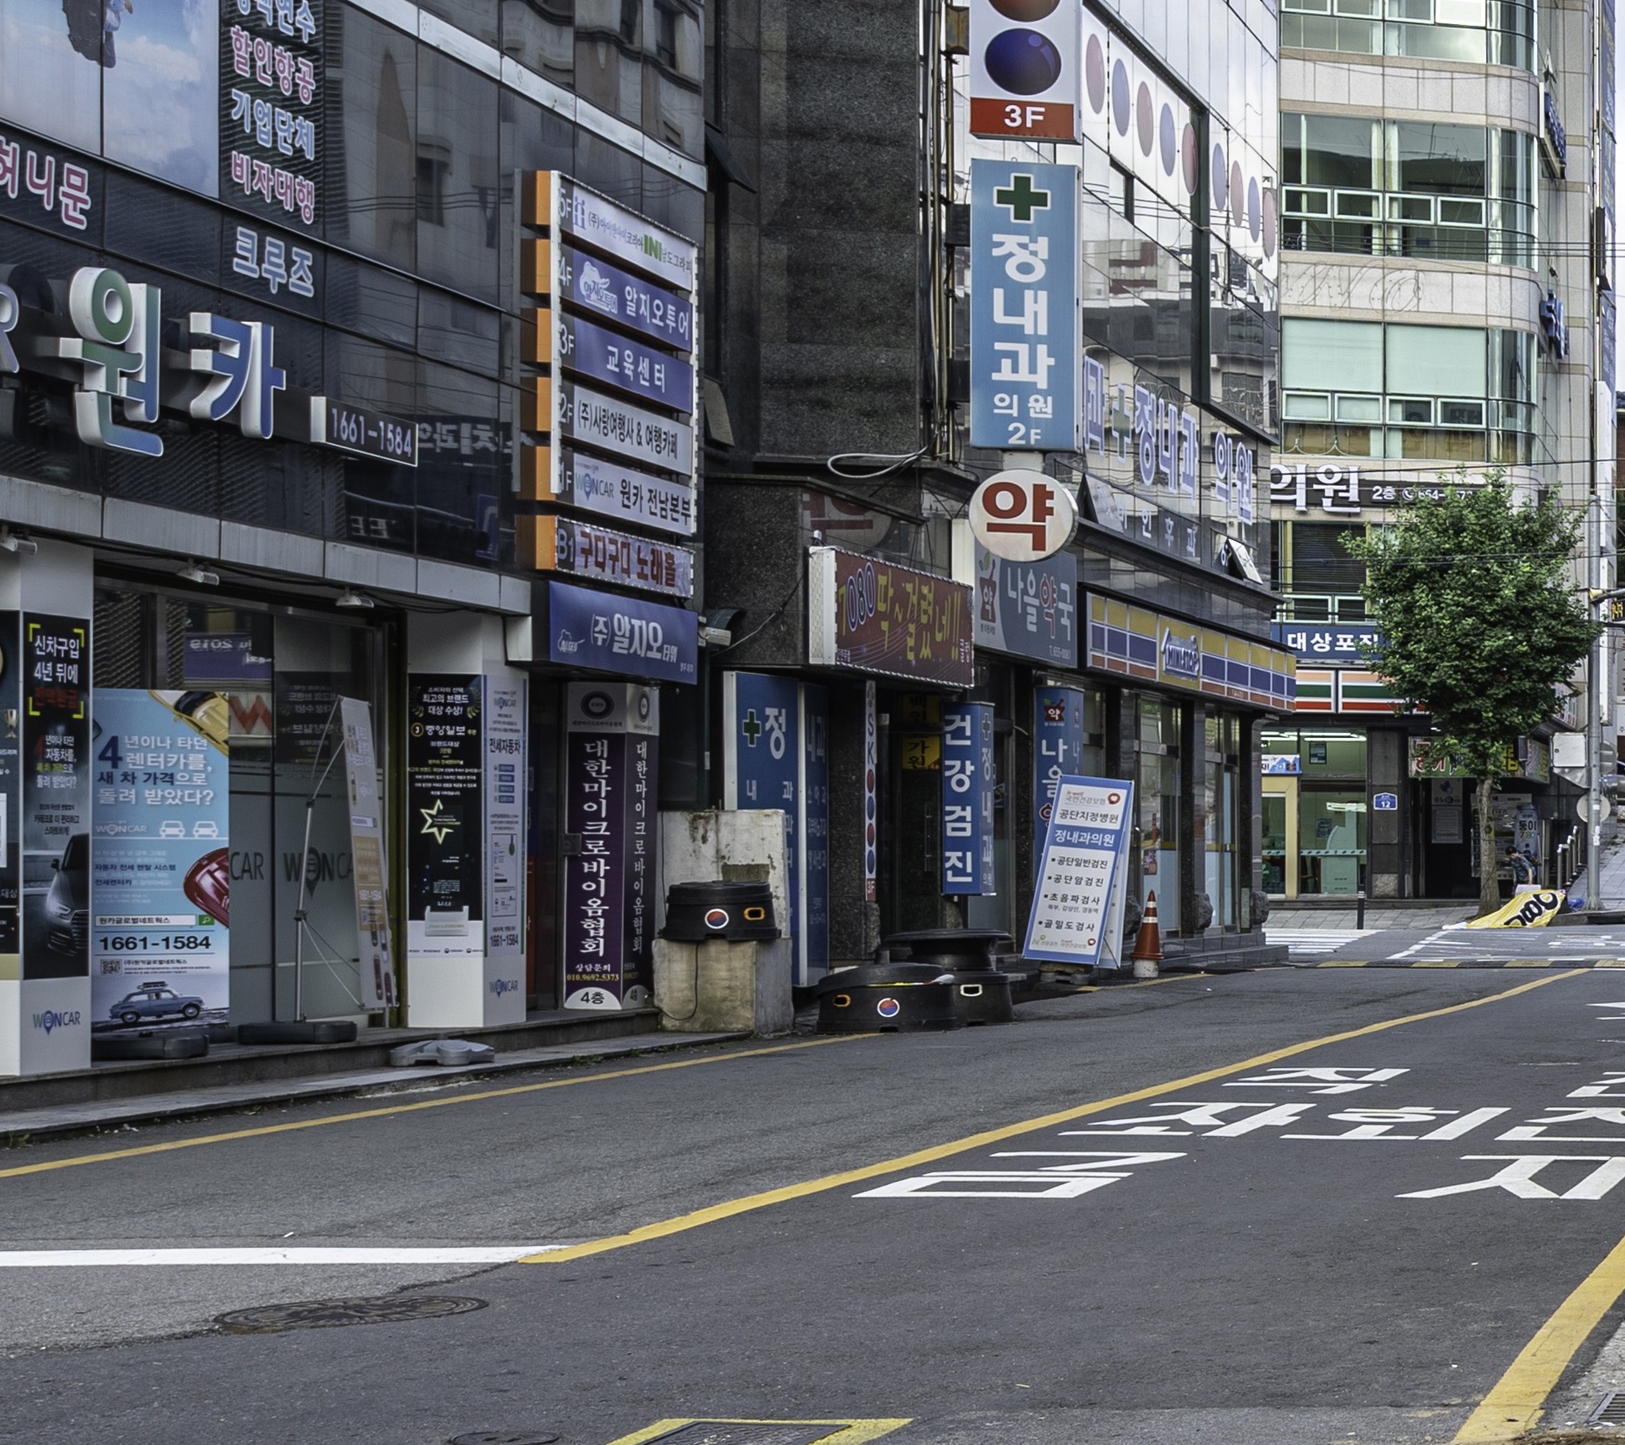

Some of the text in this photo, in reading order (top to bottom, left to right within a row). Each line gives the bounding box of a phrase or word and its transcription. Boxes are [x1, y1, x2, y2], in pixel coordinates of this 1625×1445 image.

[230, 24, 315, 105] 할인항공
[231, 88, 315, 160] 기업단체
[1003, 105, 1046, 130] 3F
[230, 150, 315, 225] 비자대행
[233, 226, 314, 298] 크루즈
[559, 257, 572, 286] 4F
[624, 285, 689, 340] 알지오투어
[991, 233, 1055, 390] 정내과
[559, 325, 574, 354] 3F
[60, 267, 286, 457] 원카
[606, 345, 665, 393] 교육센터
[560, 393, 573, 424] 2F
[992, 394, 1054, 419] 의원
[332, 408, 412, 457] 1661-1584
[577, 399, 678, 460] (주)사랑여행사 & 여행카페
[1007, 423, 1042, 446] 2F
[1135, 384, 1252, 526] 정내과 의원
[575, 472, 691, 525] WONCAR 원카 전남본부
[1270, 463, 1396, 514] 의원 2층
[981, 482, 1055, 552] 약
[557, 528, 676, 588] B1 노래홀
[838, 561, 876, 636] 7080
[1007, 567, 1073, 642] 나을약국
[34, 635, 80, 659] 신차구입
[1287, 630, 1379, 653] 대상포진
[34, 664, 79, 684] 4년 뒤에
[98, 736, 208, 769] 4 년이나 타던
[867, 713, 874, 765] SK
[126, 753, 212, 772] 렌터카를,
[98, 772, 208, 786] 새 차 가격으로
[98, 789, 215, 806] 돌려 받았다?
[944, 714, 975, 883] 건강검진
[95, 824, 147, 836] WONCAR
[1059, 809, 1119, 824] 공단지정병원
[580, 739, 612, 957] 대한마이크로바이옴협회
[1054, 829, 1115, 847] 정내과의원
[1057, 856, 1108, 870] 공단일반검진
[1049, 892, 1100, 906] 초음파검사
[1044, 918, 1095, 932] 골밀도검사
[99, 936, 211, 951] 1661-1584
[580, 991, 605, 1005] 4층
[33, 1010, 81, 1035] WONCAR
